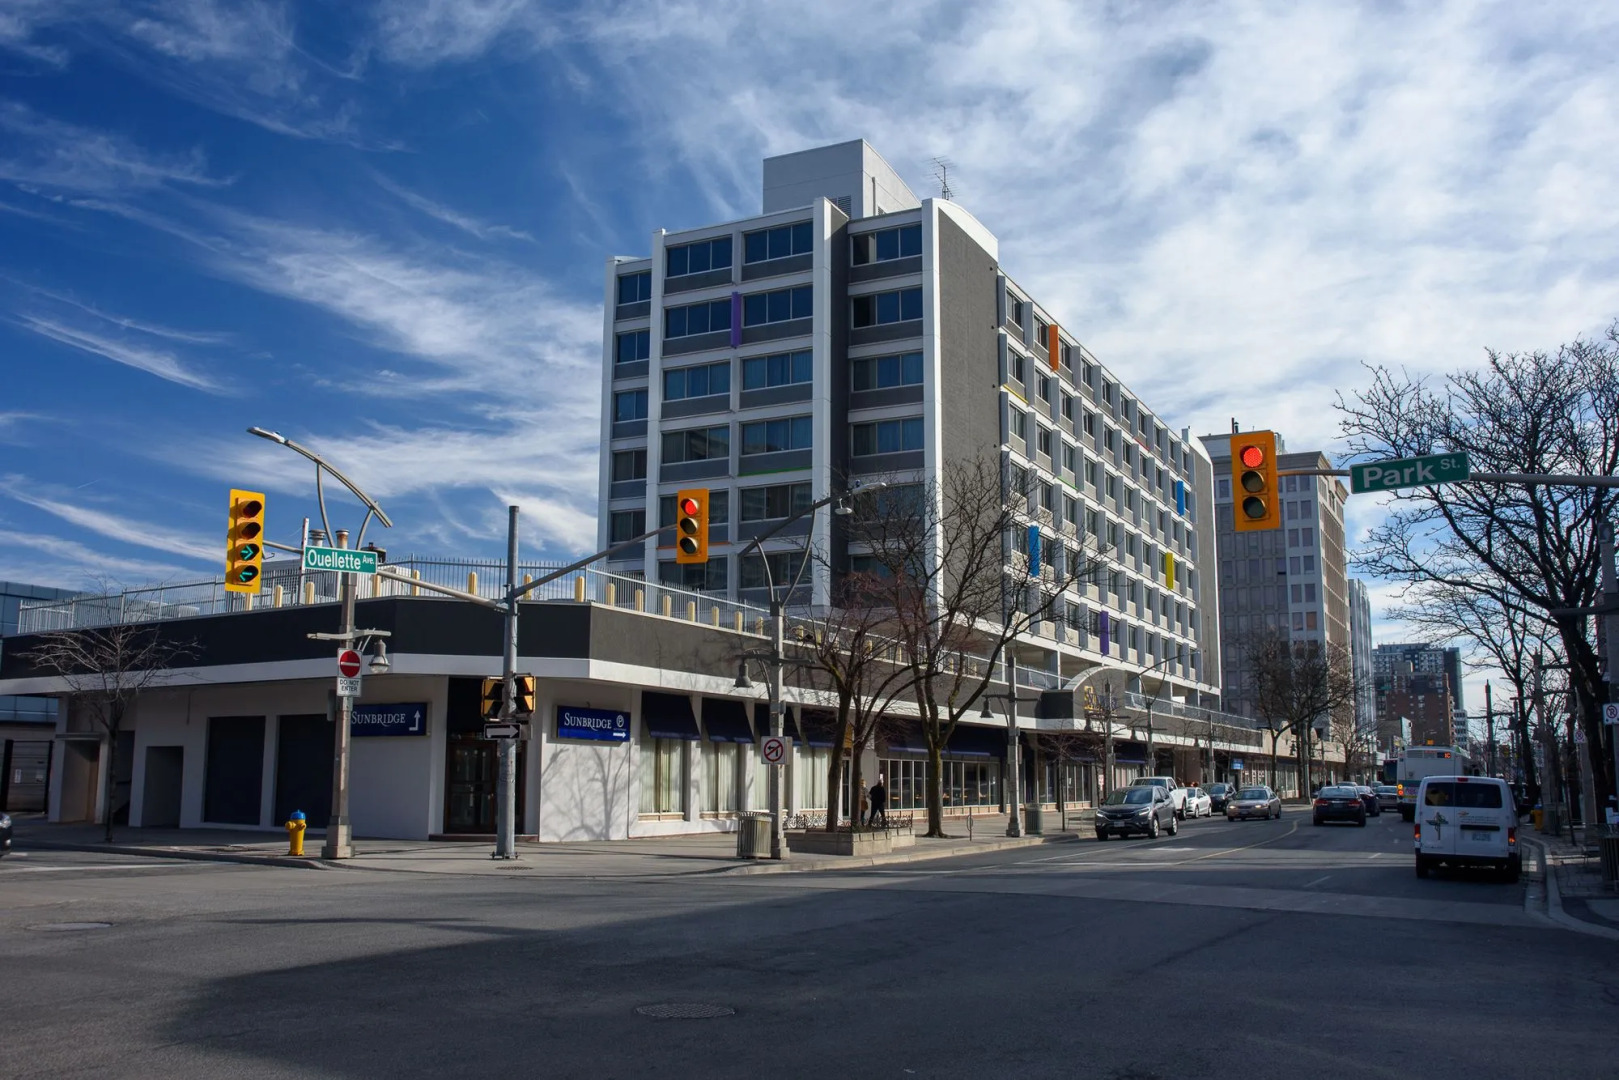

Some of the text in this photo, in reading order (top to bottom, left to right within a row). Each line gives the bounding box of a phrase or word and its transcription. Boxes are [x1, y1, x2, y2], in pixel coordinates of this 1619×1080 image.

[1363, 458, 1460, 488] Park St.
[307, 549, 374, 570] Ouellette Ave.
[352, 711, 406, 727] SUNBRIDGE
[564, 712, 612, 731] SUNBRIDGE
